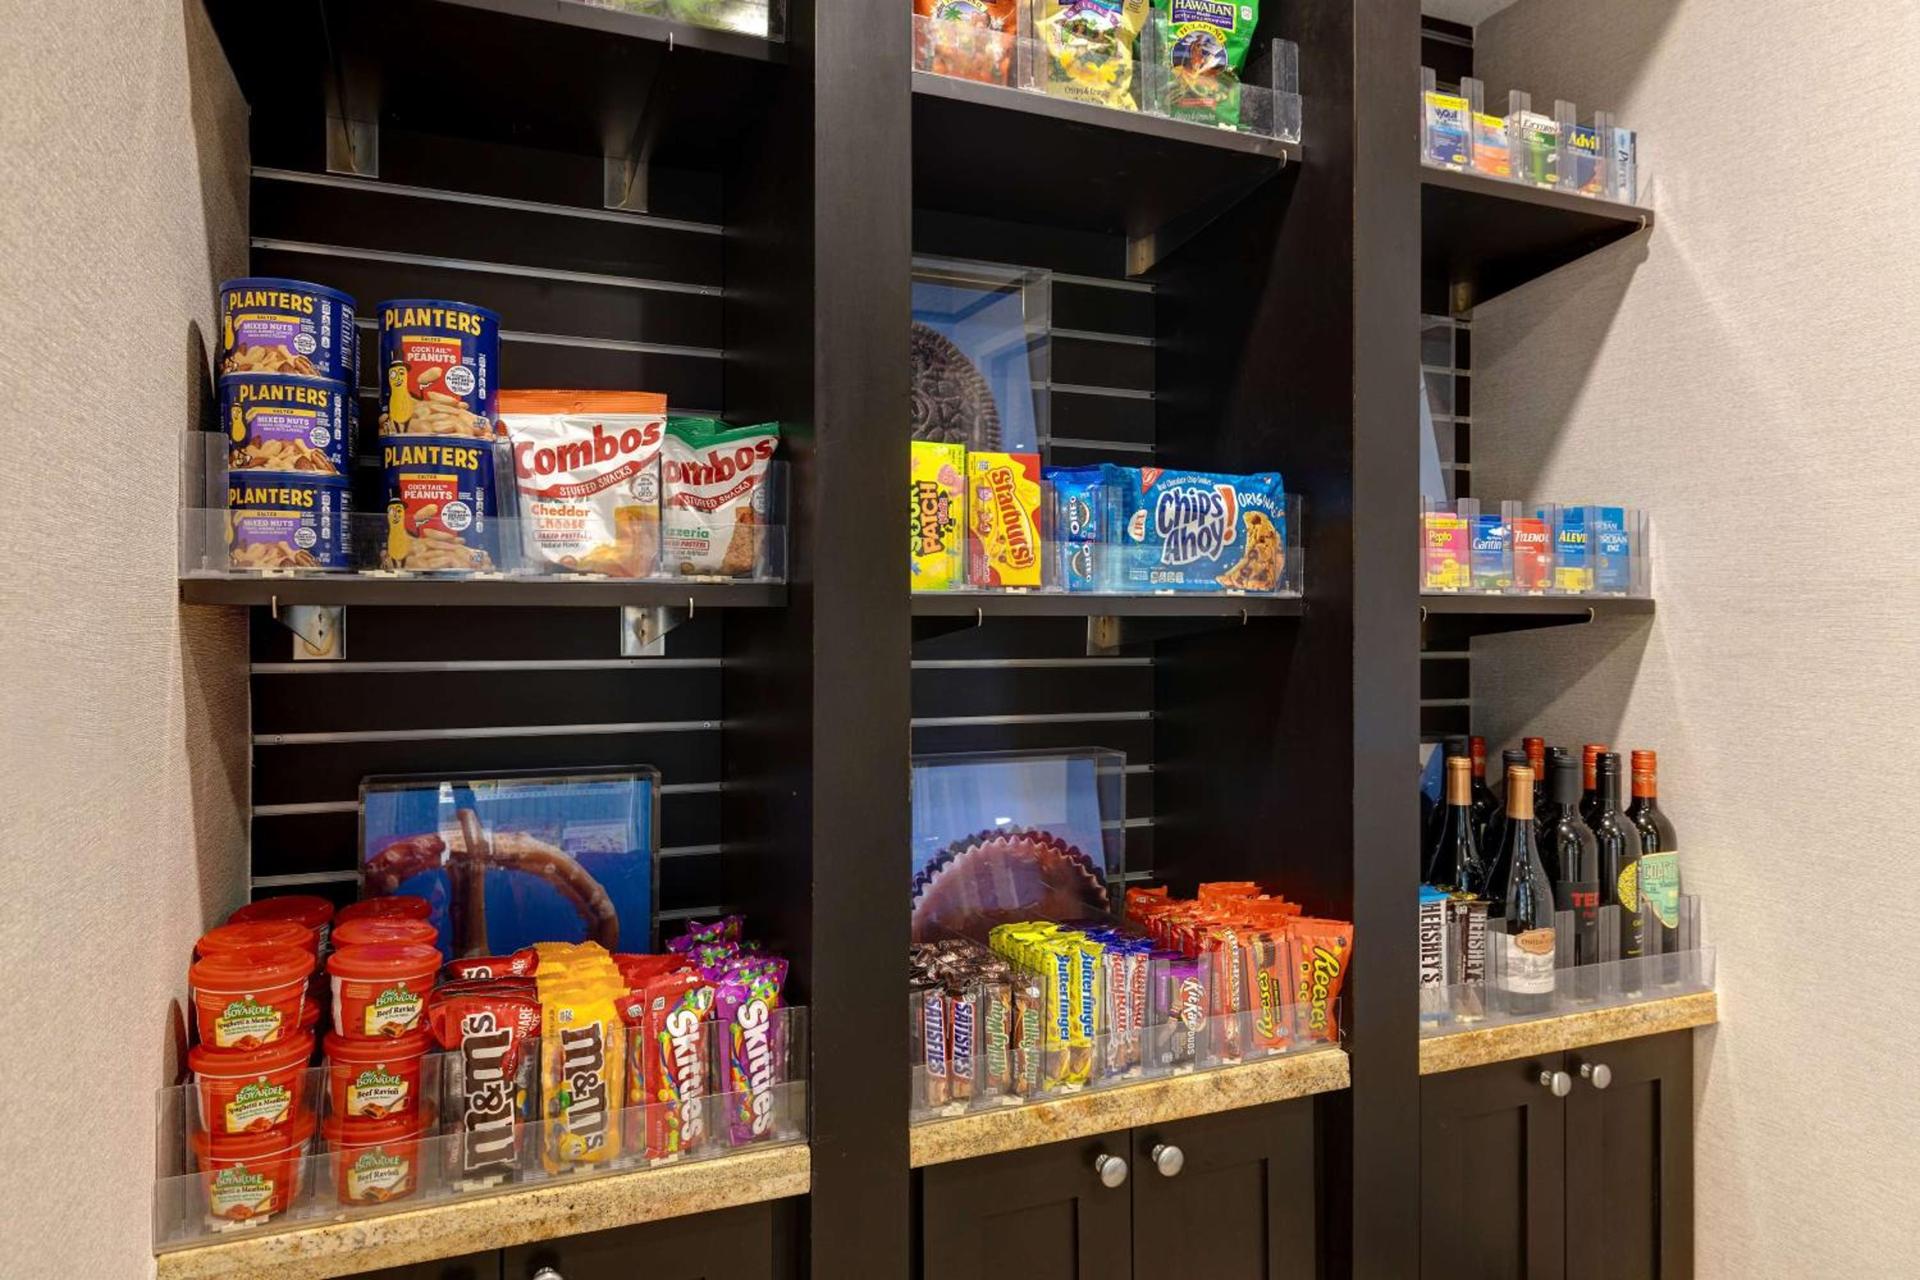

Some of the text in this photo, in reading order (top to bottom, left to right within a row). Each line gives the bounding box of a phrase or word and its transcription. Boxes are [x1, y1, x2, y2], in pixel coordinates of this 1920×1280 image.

[1176, 0, 1232, 16] HAWAIIAN
[230, 291, 314, 314] PLANTERS
[385, 308, 481, 335] PLANTERS
[244, 323, 293, 332] MIXED NUTS
[407, 353, 457, 364] PEANUTS
[240, 384, 328, 407] PLANTERS
[384, 446, 479, 470] PLANTERS
[515, 422, 662, 479] Combos
[662, 439, 773, 486] ombos
[229, 488, 314, 507] PLANTERS
[404, 491, 452, 500] PEANUTS
[559, 482, 598, 497] STUFFED
[598, 466, 633, 489] SNACKS
[531, 504, 591, 517] Cheddar
[919, 483, 943, 553] PATCH
[992, 469, 1035, 565] Starburst
[1070, 496, 1079, 535] OREO
[1158, 487, 1224, 534] Chips
[1421, 903, 1442, 983] HERSHEY'S
[1057, 953, 1071, 1041] Butterfinger
[1079, 951, 1096, 1037] Butterfinger
[1256, 970, 1274, 1039] Reese's
[1309, 945, 1341, 1031] Reese's
[223, 1005, 273, 1019] BOYARDEE
[926, 999, 946, 1076] SATISFIES
[954, 1002, 973, 1079] SATISFIES
[665, 1010, 702, 1141] Skittles
[737, 998, 774, 1135] Skittles
